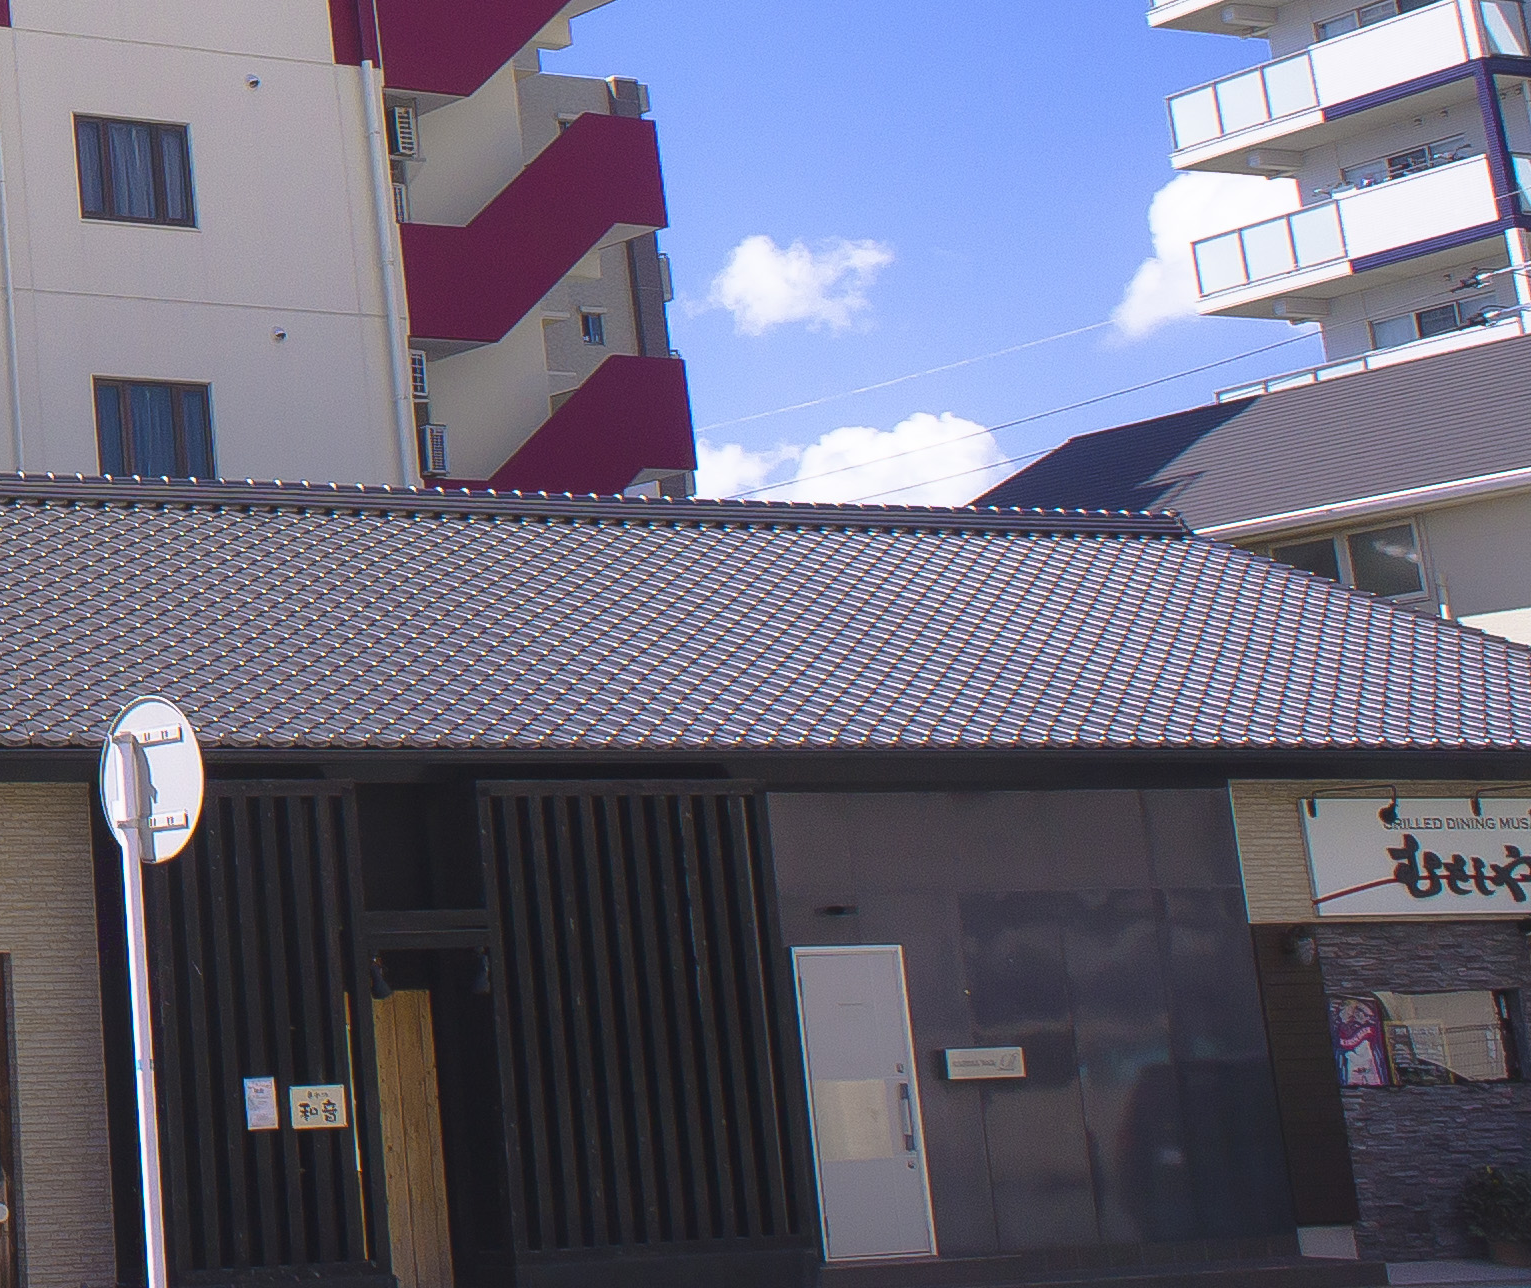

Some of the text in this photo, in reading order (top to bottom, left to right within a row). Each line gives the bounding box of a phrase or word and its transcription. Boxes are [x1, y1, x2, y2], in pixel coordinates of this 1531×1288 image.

[1446, 817, 1495, 830] DINING
[1499, 817, 1531, 830] MUS
[1387, 833, 1531, 903] むさしや
[298, 1098, 338, 1123] 和音
